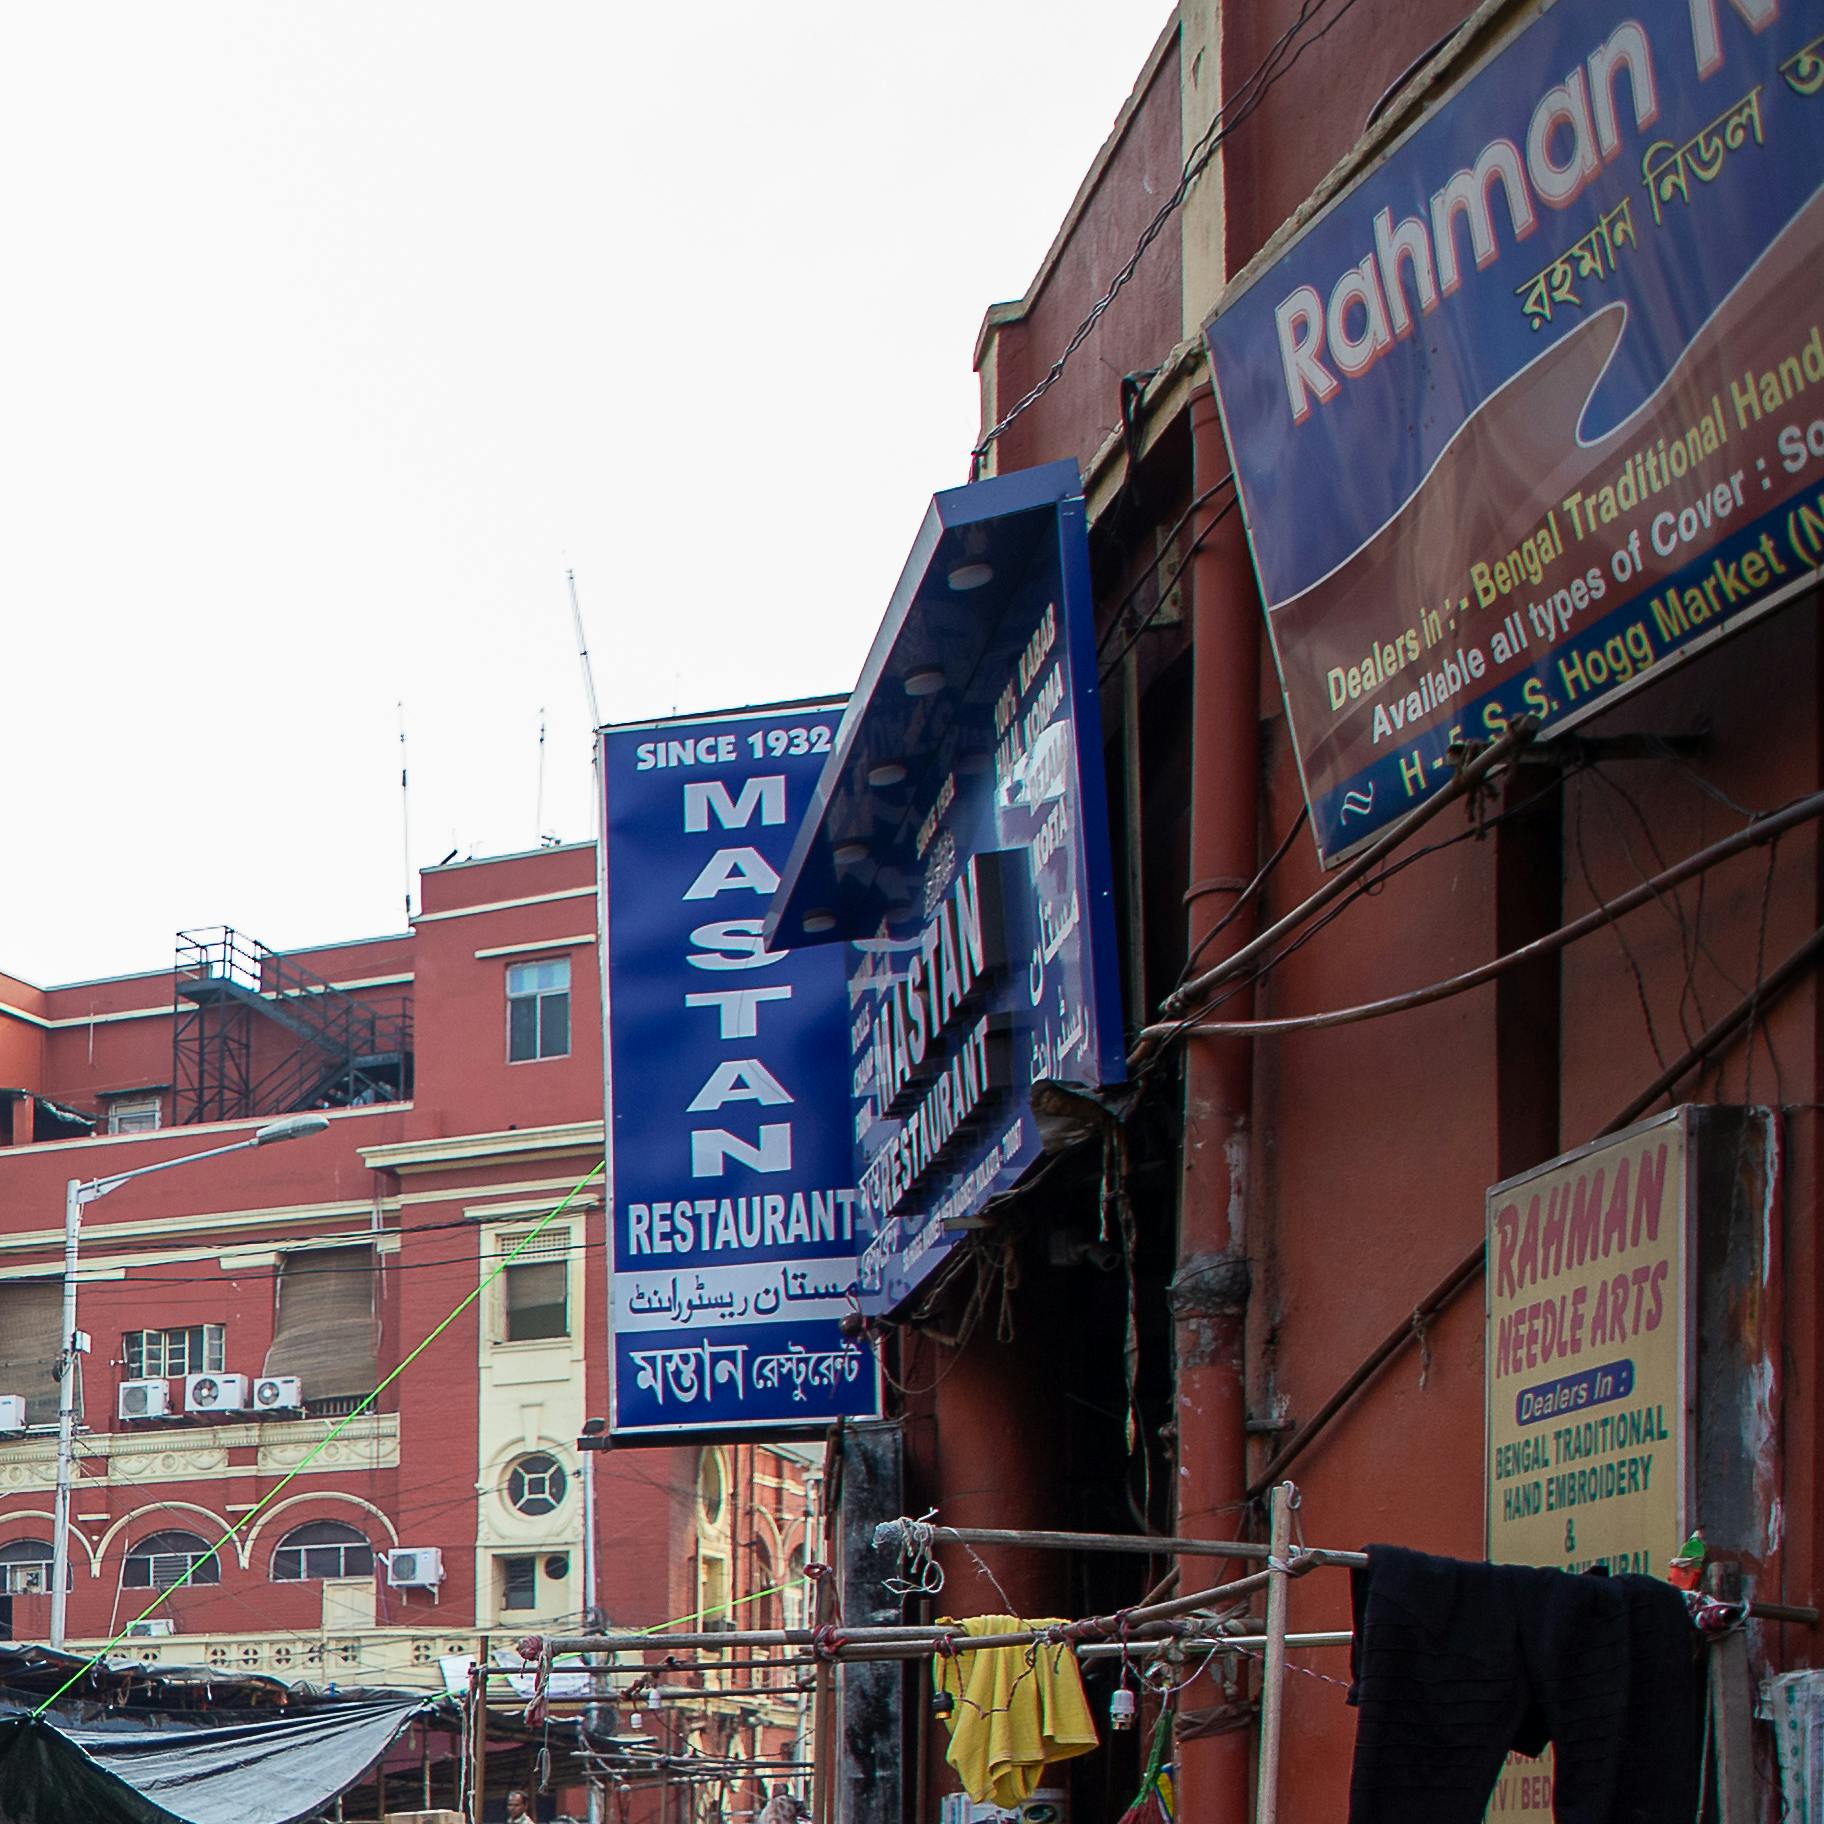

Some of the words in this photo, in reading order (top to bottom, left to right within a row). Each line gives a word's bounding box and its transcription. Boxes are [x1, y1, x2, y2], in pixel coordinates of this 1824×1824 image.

[1273, 20, 1658, 426] Rahman
[1514, 196, 1636, 332] রহমান
[1325, 626, 1421, 712] Dealers
[1420, 606, 1445, 650] in
[1469, 510, 1566, 610] Bengal
[1562, 394, 1728, 543] Traditional
[1371, 646, 1486, 744] Available
[1491, 610, 1529, 666] all
[1529, 563, 1607, 644] types
[1611, 528, 1645, 584] of
[1650, 466, 1746, 560] Cover
[1557, 610, 1654, 702] Hogg
[1650, 530, 1788, 645] Market
[636, 734, 738, 771] SINCE
[747, 725, 833, 760] 1932
[682, 775, 795, 1178] MASTAN
[873, 853, 986, 1122] MASTAN
[882, 1015, 990, 1218] RESTAURANT
[628, 1188, 857, 1256] RESTAURANT
[1495, 1143, 1668, 1299] RAHMAN
[628, 1337, 749, 1405] মস্তান
[1495, 1285, 1588, 1378] NEEDLE
[1590, 1259, 1669, 1347] ARTS
[1495, 1434, 1550, 1481] BENGAL
[1552, 1404, 1668, 1466] TRADITIONAL
[1519, 1378, 1589, 1422] Dealers
[1593, 1371, 1614, 1398] In
[1503, 1479, 1542, 1522] HAND
[1546, 1454, 1652, 1511] EMBROIDERY
[1564, 1518, 1576, 1554] &
